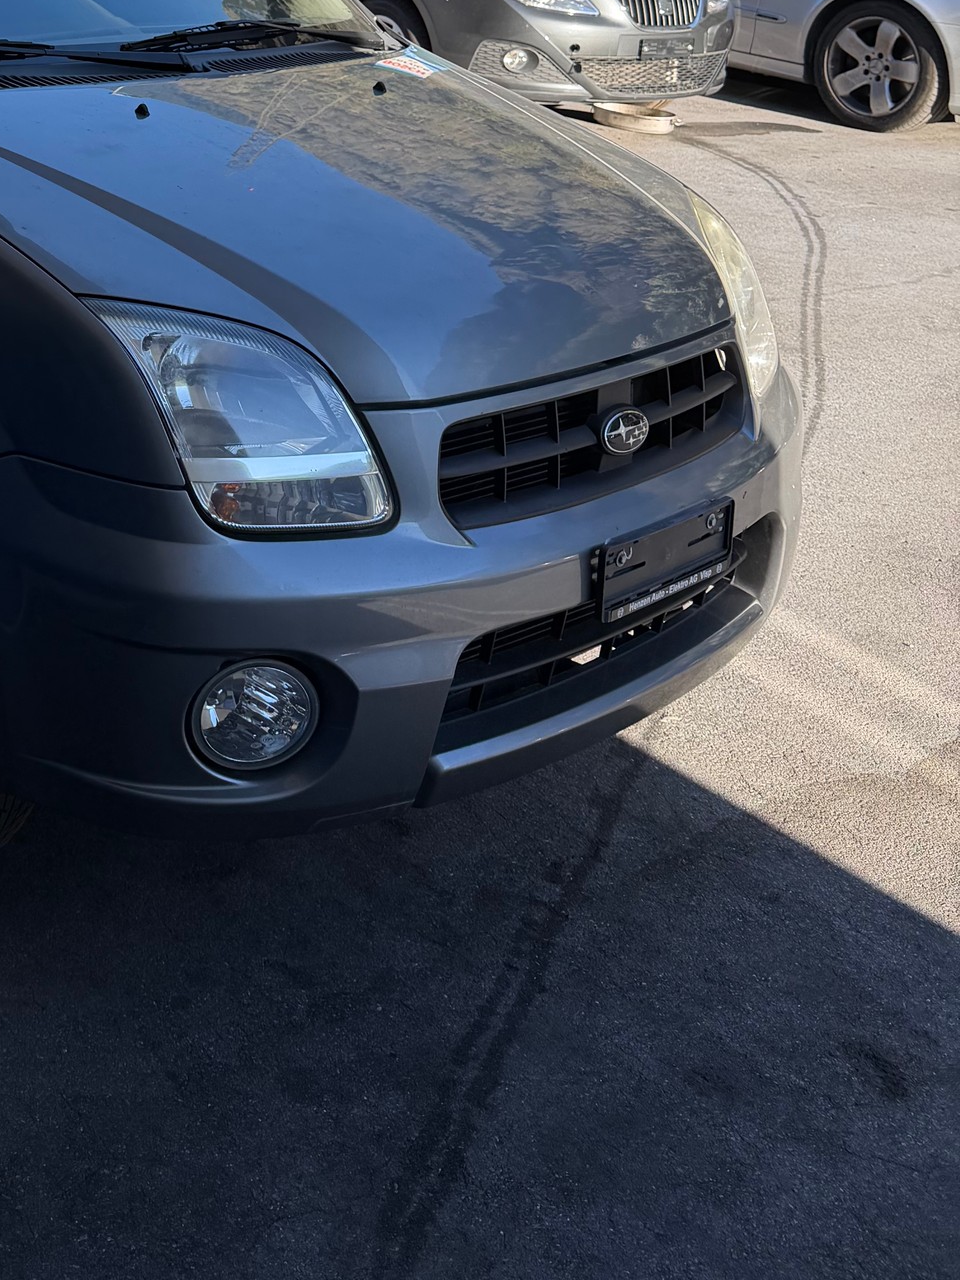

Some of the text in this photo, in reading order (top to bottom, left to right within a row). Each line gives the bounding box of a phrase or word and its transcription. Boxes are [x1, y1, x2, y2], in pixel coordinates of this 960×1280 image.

[651, 590, 665, 604] Auto
[668, 579, 689, 594] Elektro
[688, 573, 698, 585] AG
